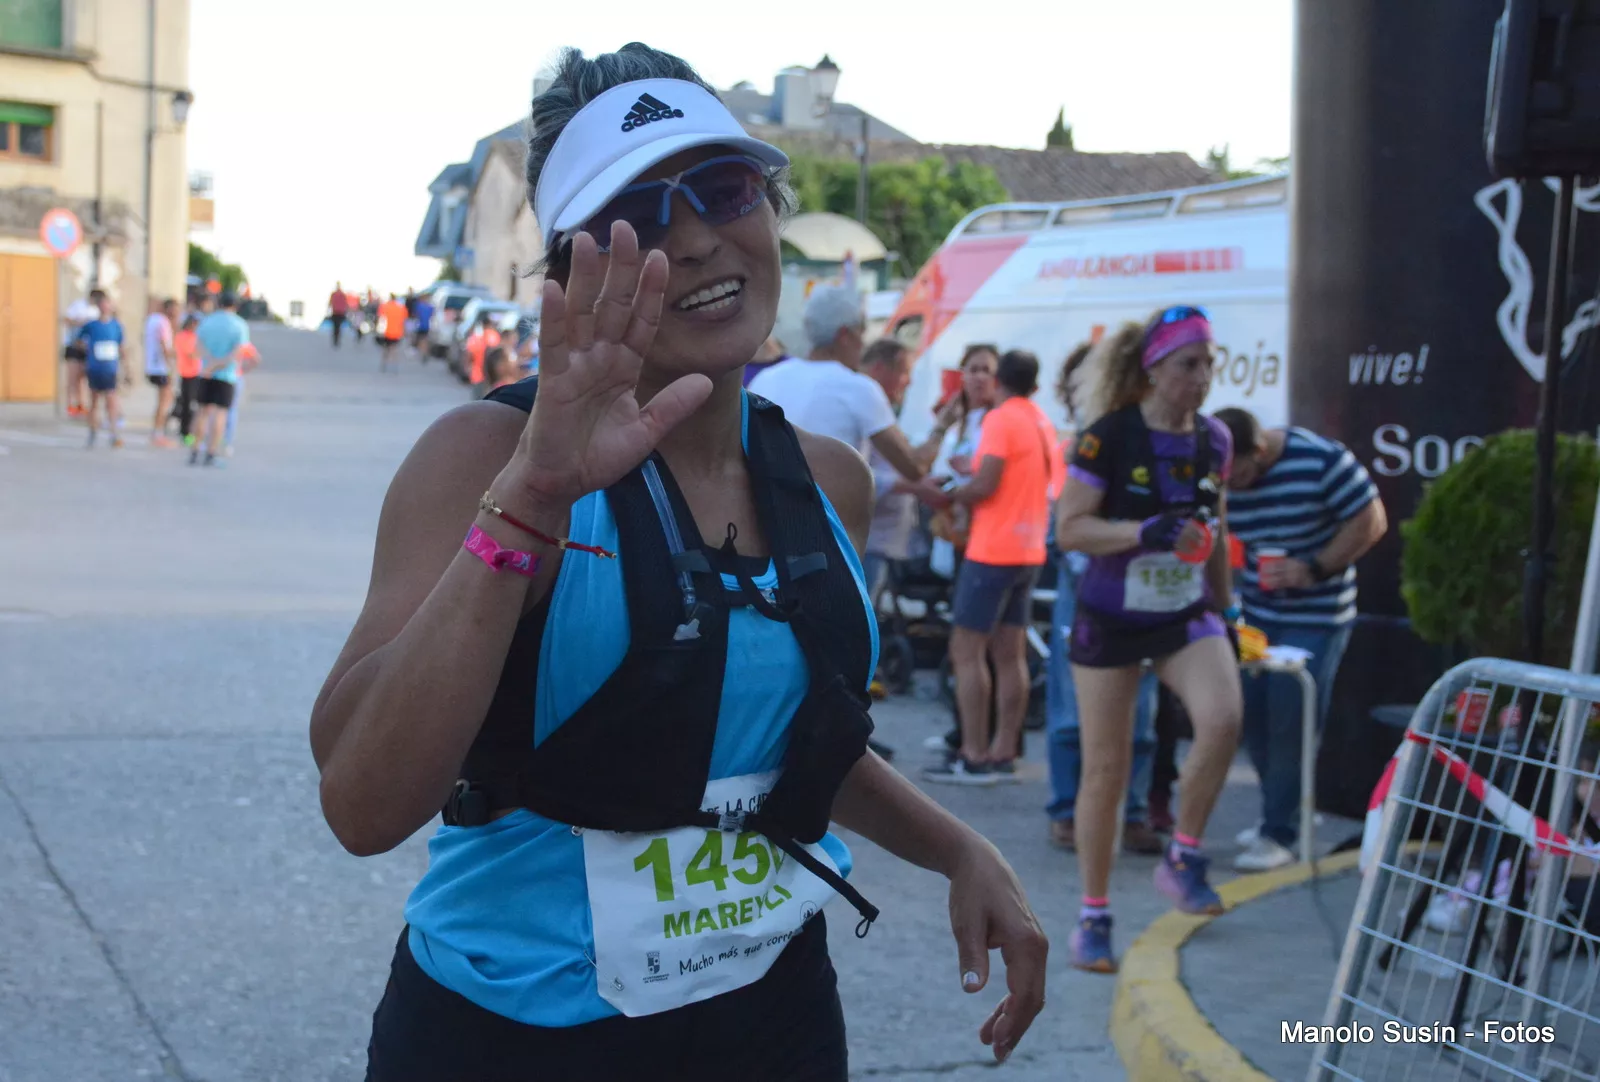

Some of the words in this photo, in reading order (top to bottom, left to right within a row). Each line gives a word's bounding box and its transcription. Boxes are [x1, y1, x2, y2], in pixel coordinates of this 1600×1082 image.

[620, 108, 685, 133] adidas
[1211, 340, 1279, 397] Roja
[1348, 343, 1430, 386] vive!
[679, 954, 714, 975] Mucho
[718, 945, 738, 961] más
[744, 942, 762, 957] que
